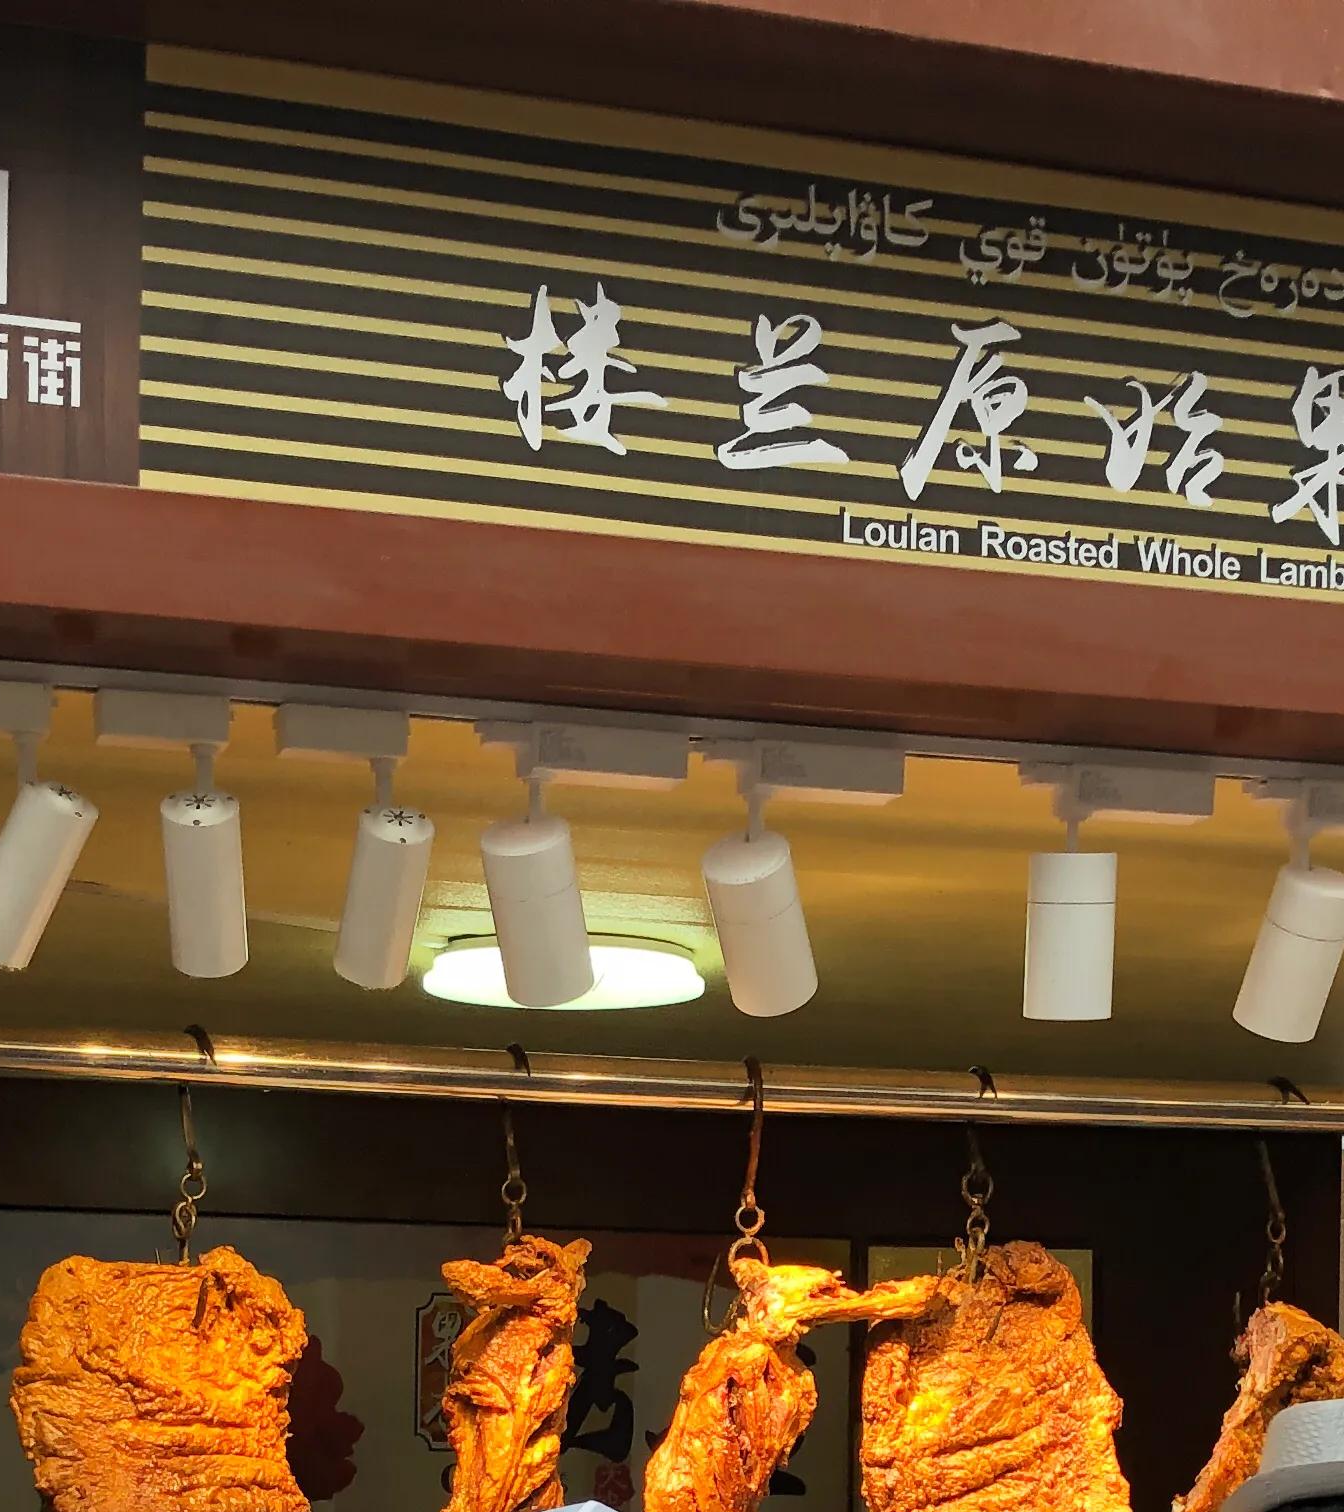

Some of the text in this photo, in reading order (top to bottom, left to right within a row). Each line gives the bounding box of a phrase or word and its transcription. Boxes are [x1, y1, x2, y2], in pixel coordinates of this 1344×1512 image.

[841, 511, 960, 554] Loulan
[981, 524, 1119, 569] Roasted
[1136, 540, 1241, 581] Whole
